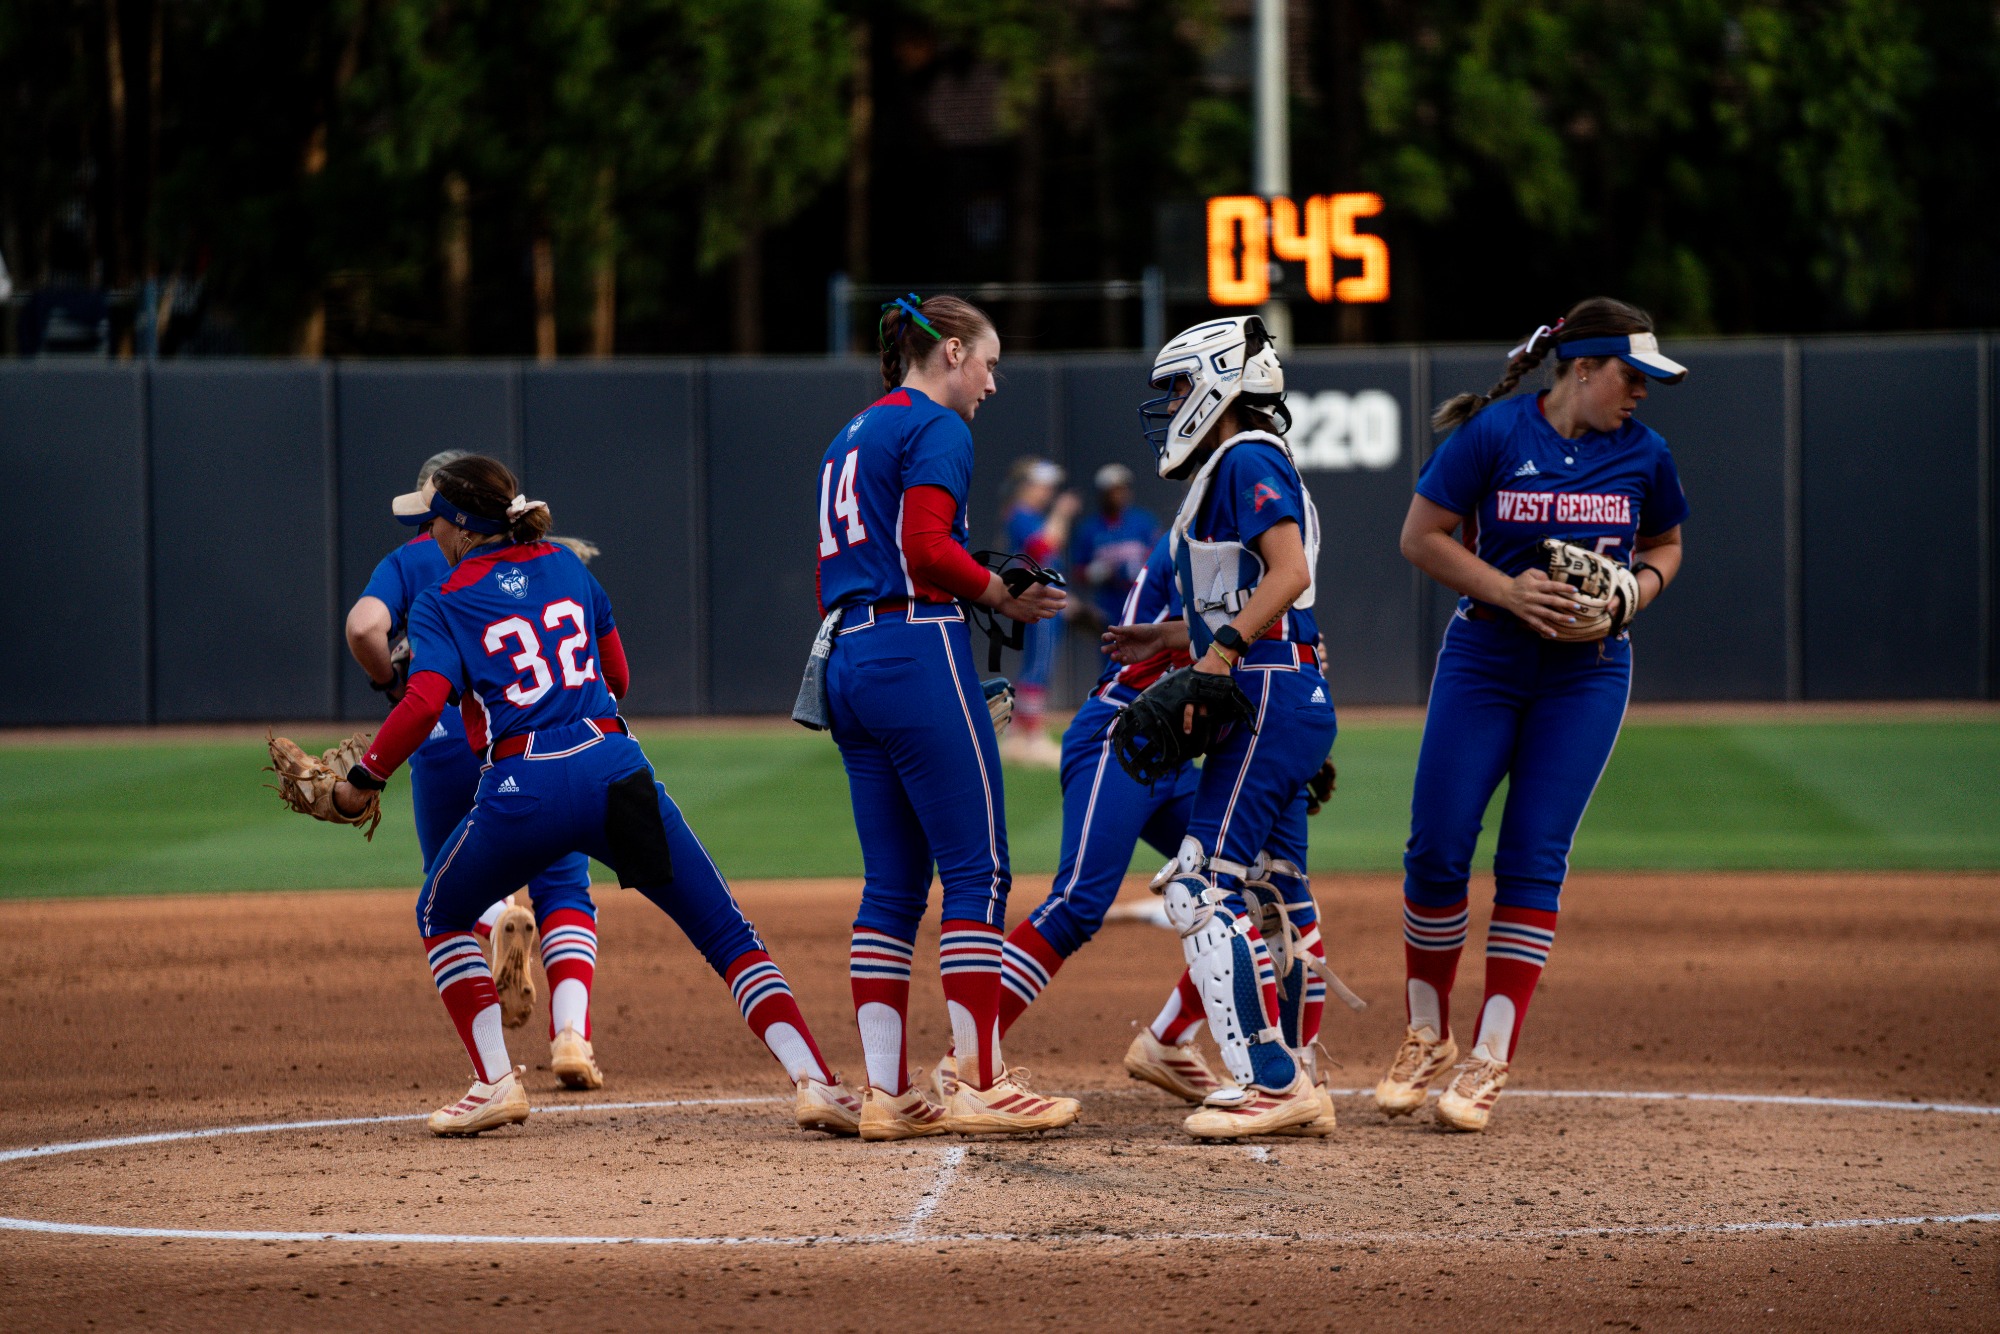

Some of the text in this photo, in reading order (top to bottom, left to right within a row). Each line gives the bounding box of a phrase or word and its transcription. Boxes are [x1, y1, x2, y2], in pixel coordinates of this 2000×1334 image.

[1287, 390, 1399, 469] 220
[818, 446, 869, 560] 14
[1496, 490, 1632, 525] WEST GEORGIA
[481, 597, 598, 710] 32
[497, 785, 520, 793] adidas
